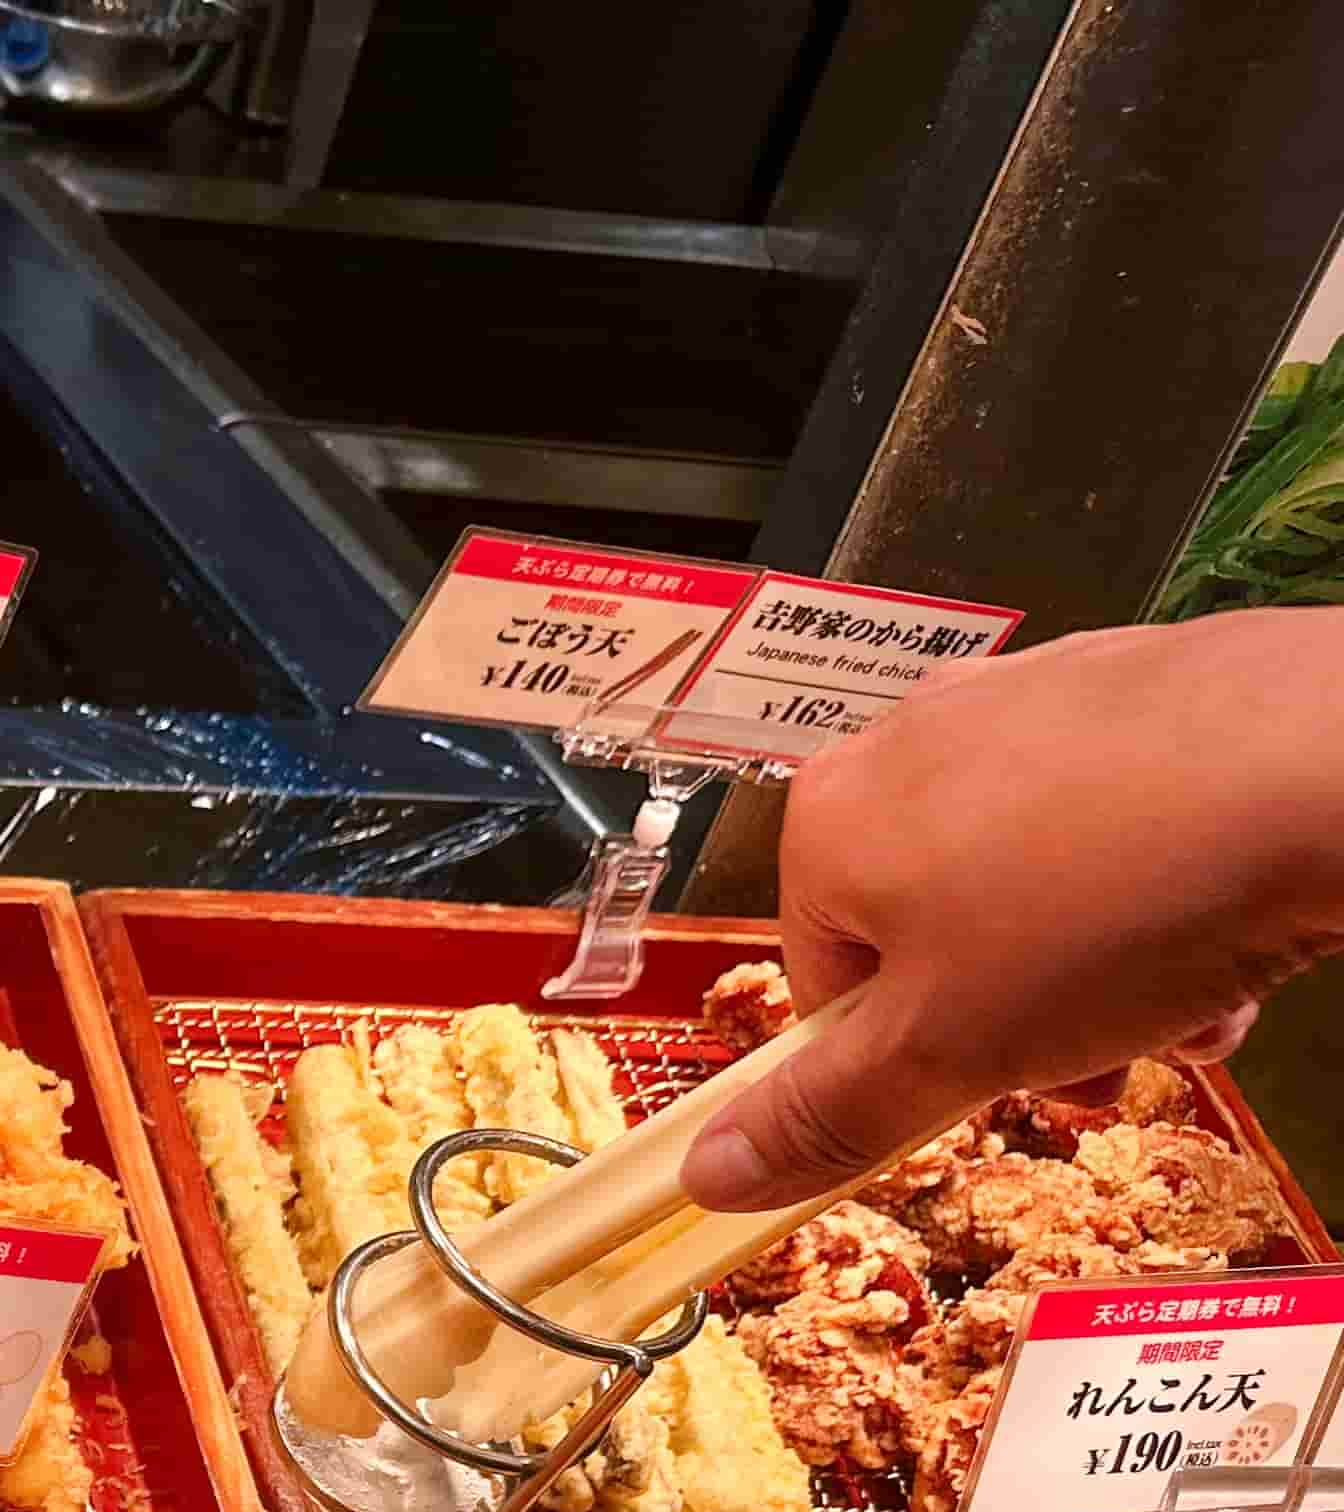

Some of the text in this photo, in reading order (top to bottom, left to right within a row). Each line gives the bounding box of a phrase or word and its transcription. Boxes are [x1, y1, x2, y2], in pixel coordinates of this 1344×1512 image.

[497, 616, 636, 658] ごぼう天
[480, 660, 569, 694] ¥140
[746, 642, 928, 681] Japanese fried chick
[759, 696, 845, 729] ¥162
[1136, 1340, 1224, 1365] 期間限定
[1066, 1368, 1266, 1419] れんこん天
[1083, 1429, 1183, 1476] ¥190
